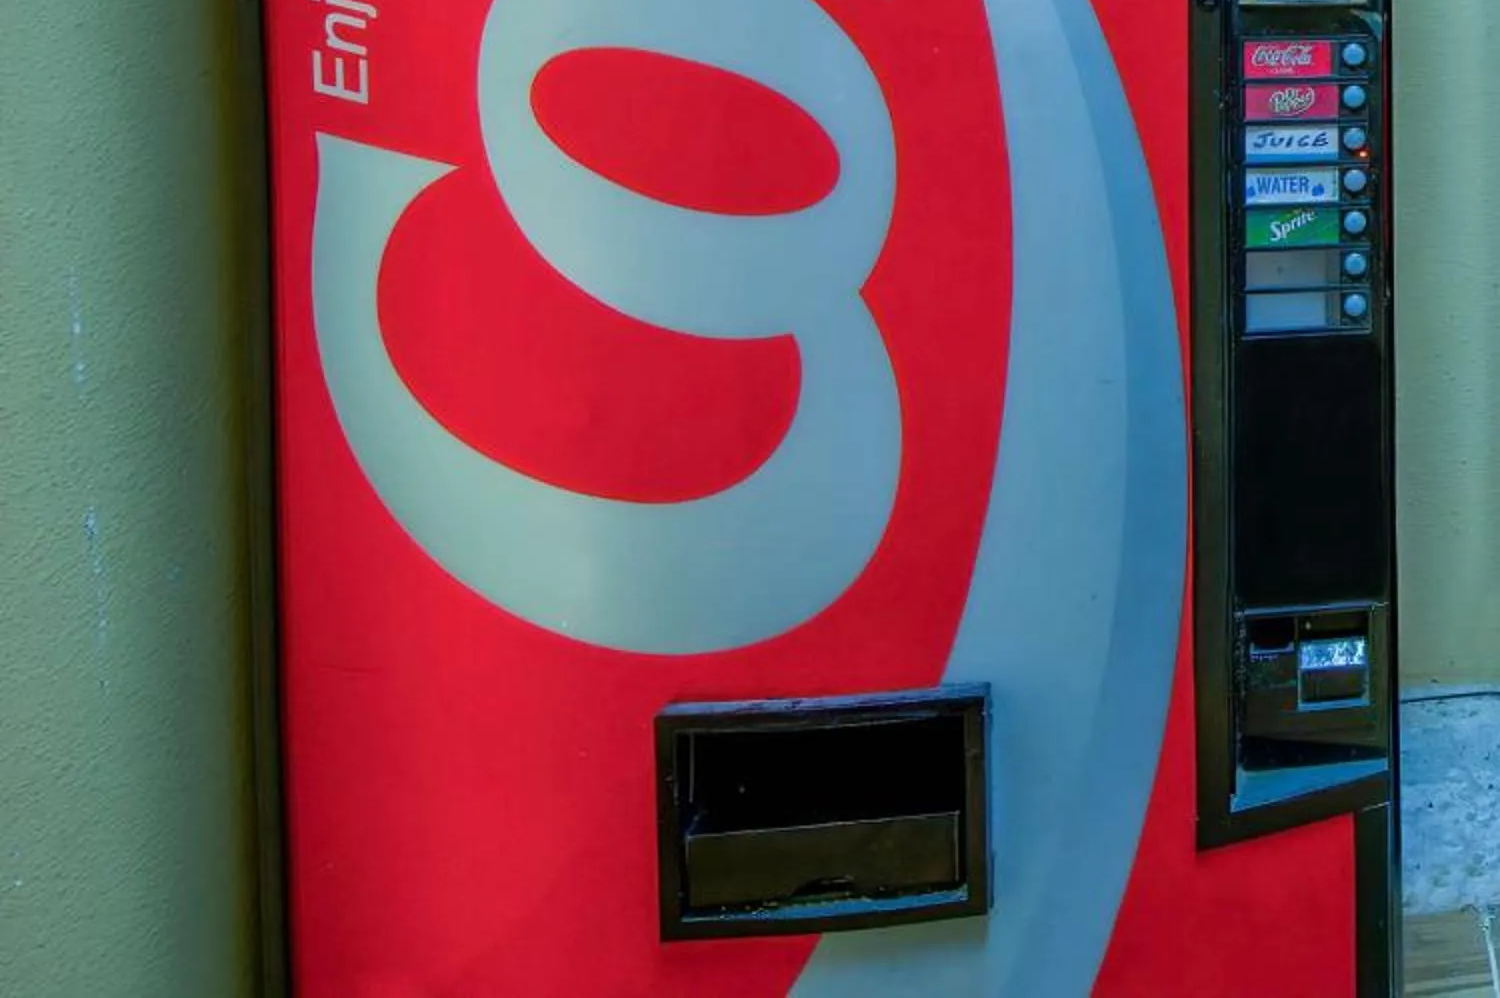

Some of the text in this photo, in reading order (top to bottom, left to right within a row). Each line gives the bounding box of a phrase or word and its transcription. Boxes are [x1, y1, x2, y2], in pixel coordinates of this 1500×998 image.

[1251, 44, 1313, 66] Coca-Cola
[1252, 132, 1329, 149] JUICE
[1256, 176, 1310, 195] WATER
[1269, 209, 1317, 242] Sprite
